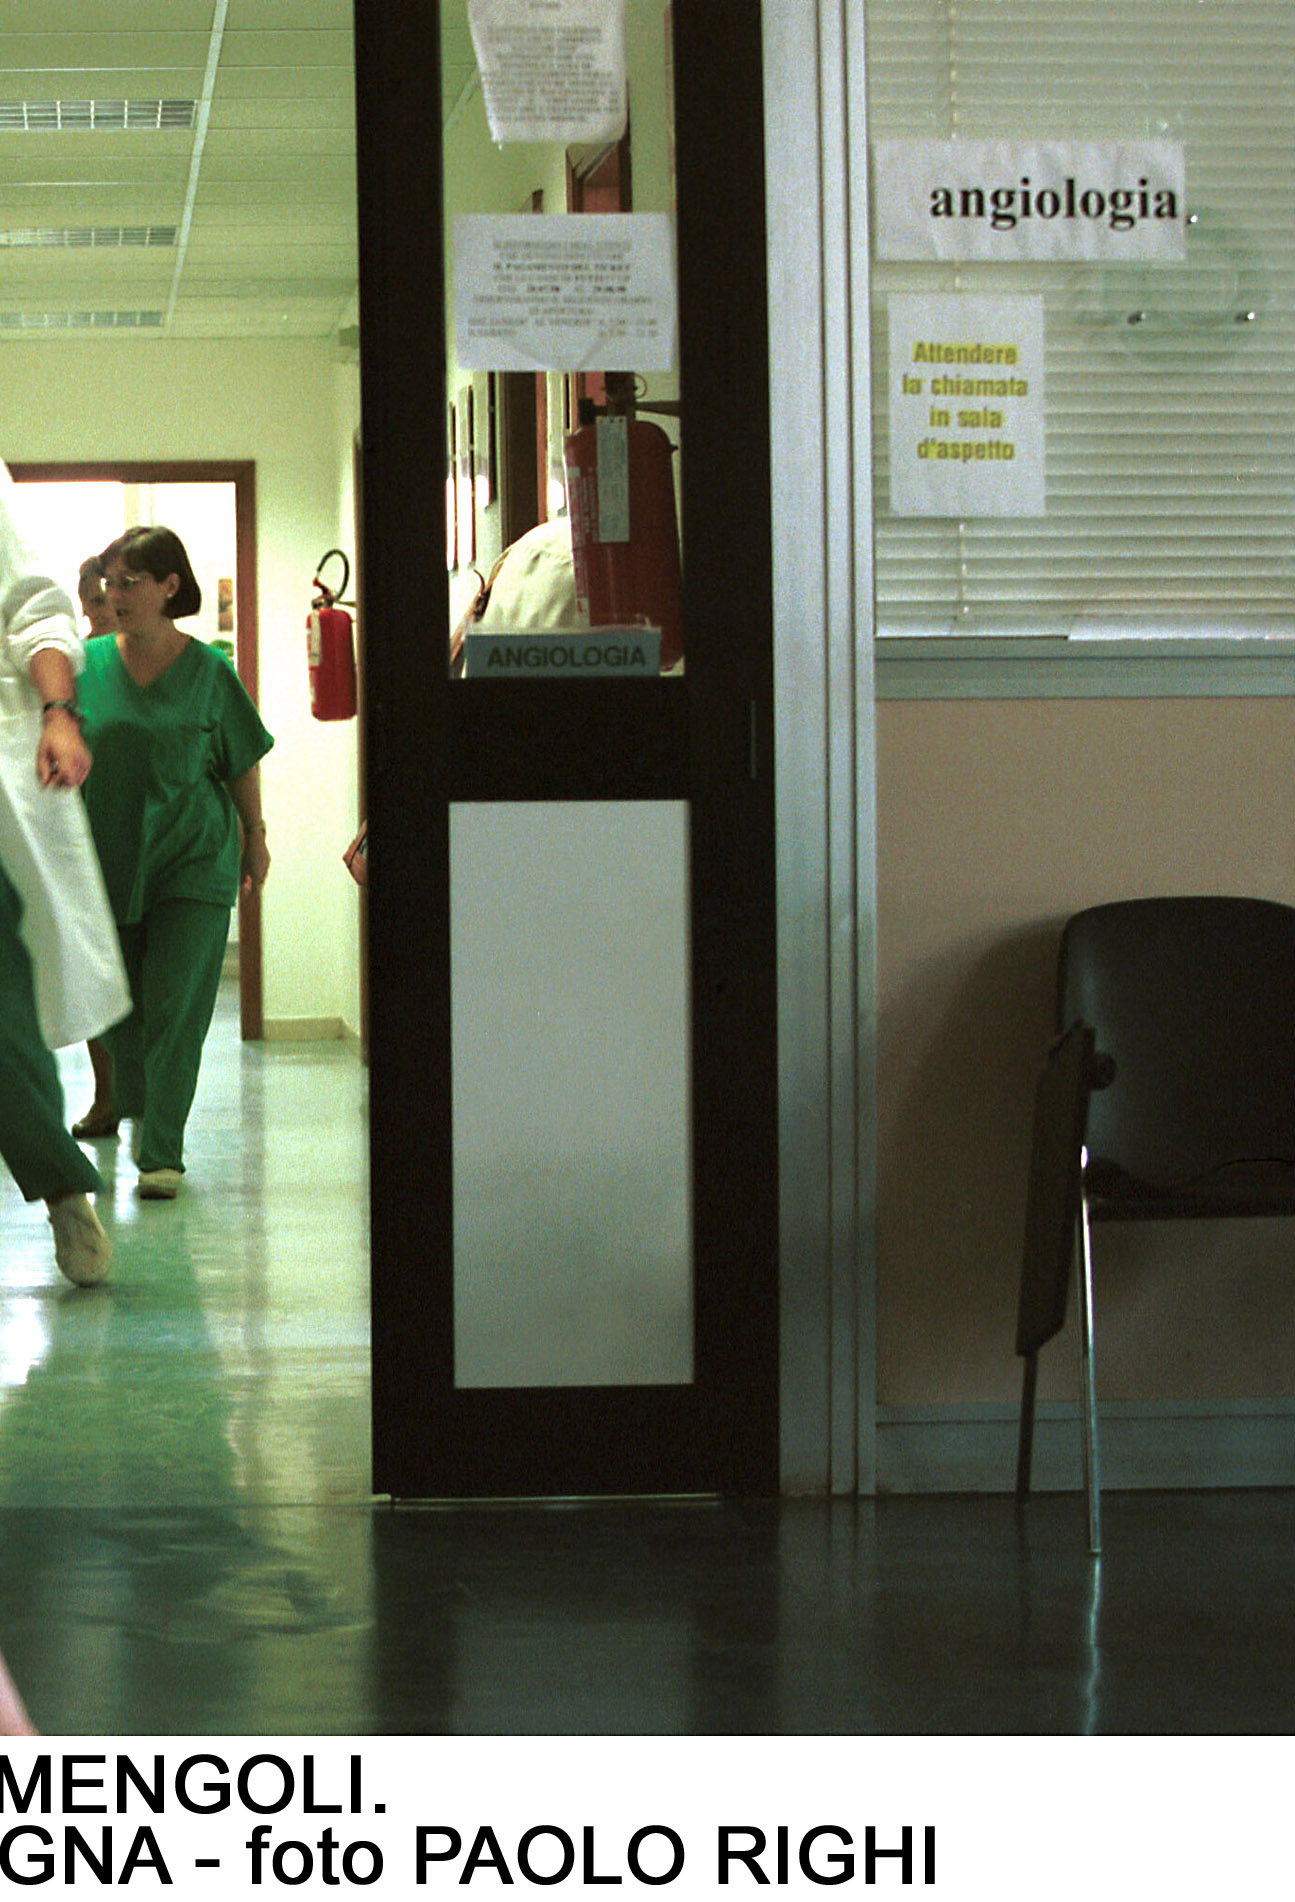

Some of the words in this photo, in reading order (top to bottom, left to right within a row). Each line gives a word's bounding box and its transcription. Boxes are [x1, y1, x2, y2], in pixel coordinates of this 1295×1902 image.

[929, 176, 1179, 232] angiologia
[913, 341, 1017, 365] Attendere
[902, 374, 921, 395] la
[931, 374, 1028, 397] chiamata
[929, 405, 949, 427] in
[957, 406, 1002, 428] sala
[917, 438, 1014, 464] d'aspetto
[487, 645, 647, 668] ANGIOLOGIA
